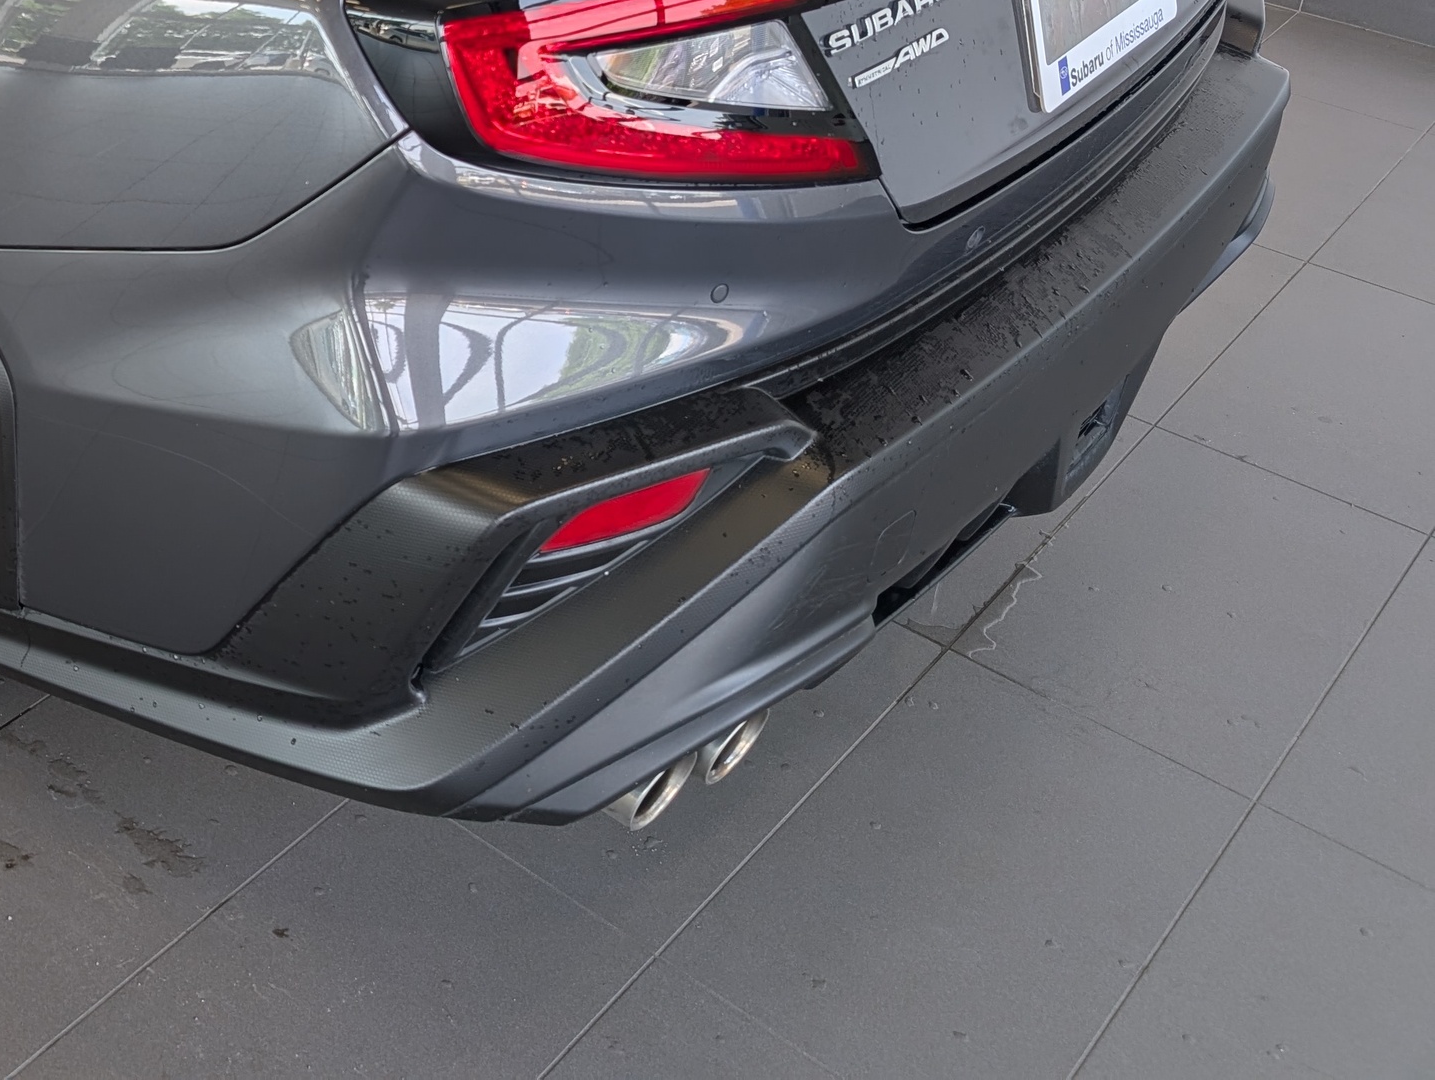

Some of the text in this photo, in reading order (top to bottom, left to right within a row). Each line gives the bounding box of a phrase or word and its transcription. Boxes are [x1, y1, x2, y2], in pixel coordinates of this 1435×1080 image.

[894, 27, 950, 69] AWD
[1070, 8, 1164, 87] Subaru of Mississauga
